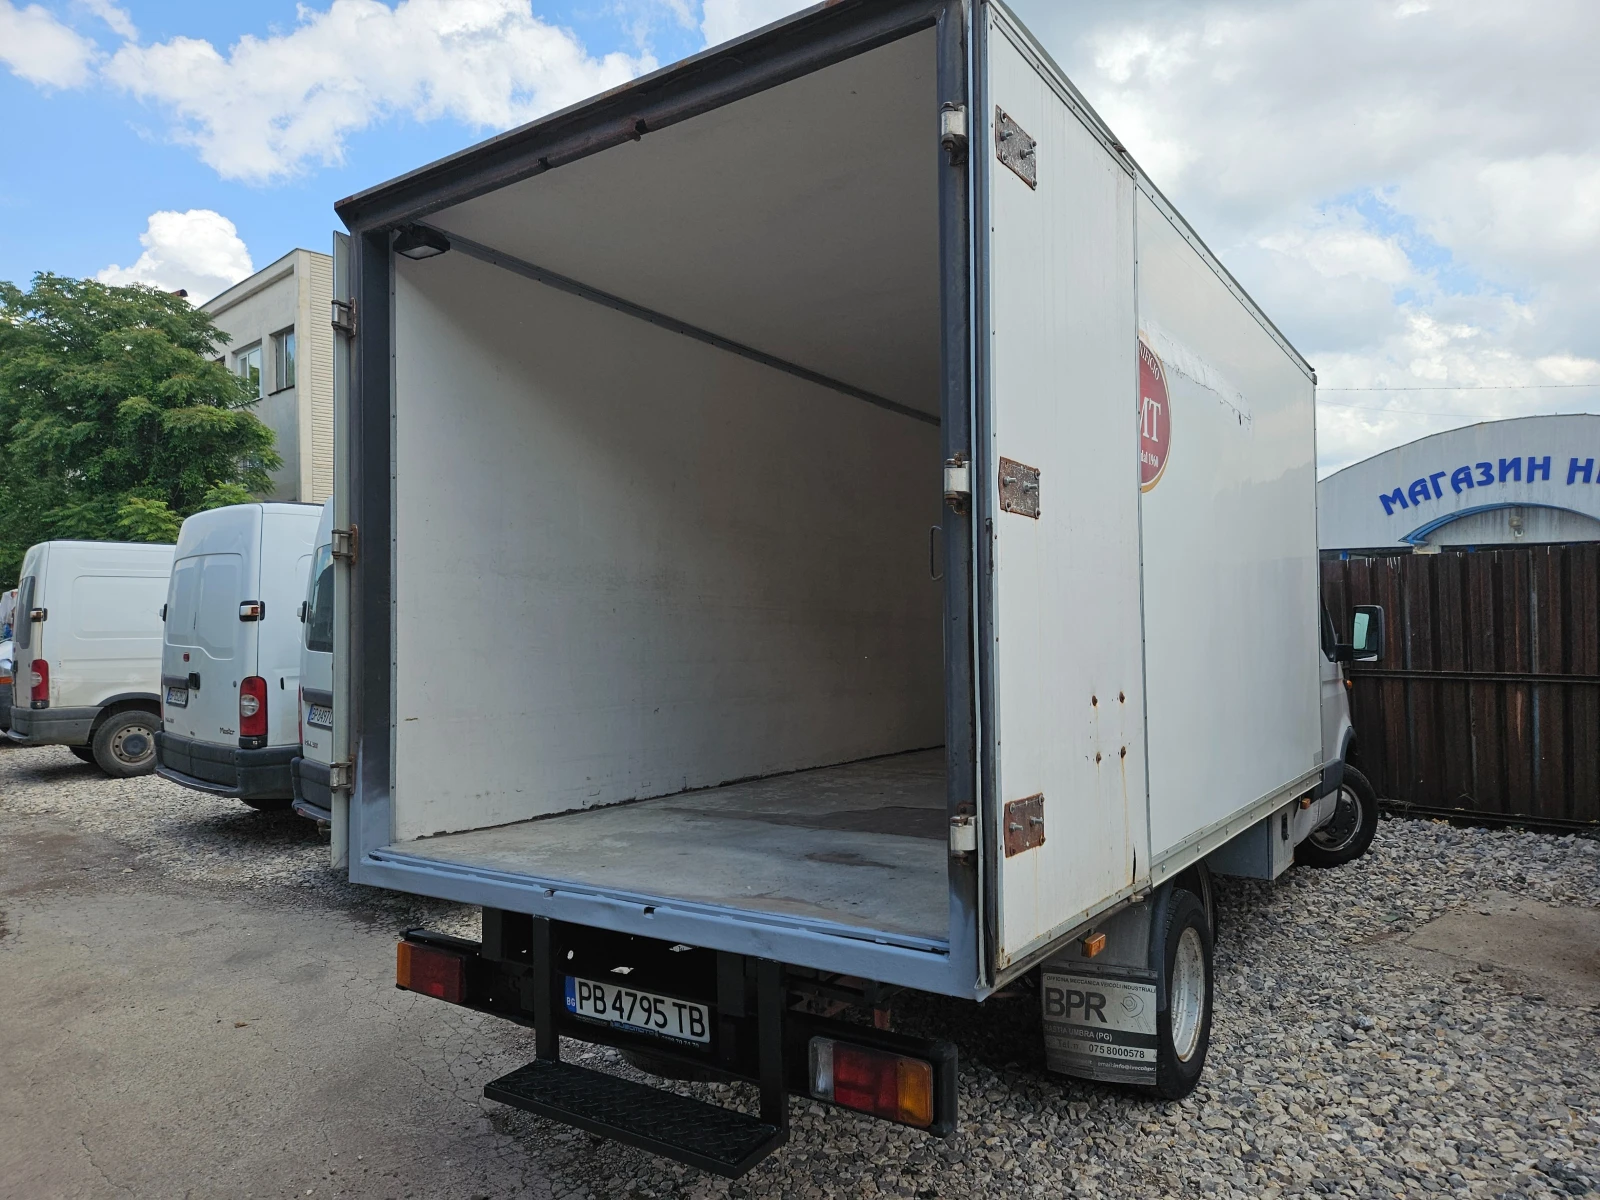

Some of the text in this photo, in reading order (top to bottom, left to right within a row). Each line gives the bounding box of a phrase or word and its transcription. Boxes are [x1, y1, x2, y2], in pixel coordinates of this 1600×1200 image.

[1379, 456, 1600, 516] МАГАЗИН Н
[1069, 978, 1100, 987] MECCANICA
[566, 997, 576, 1007] BG
[578, 981, 706, 1038] PB 4795 TB
[1045, 987, 1107, 1023] BPR
[1068, 1027, 1095, 1039] UMBRA
[1095, 1031, 1113, 1043] (PG)
[1088, 1043, 1105, 1054] 075
[1106, 1046, 1145, 1059] 8000578
